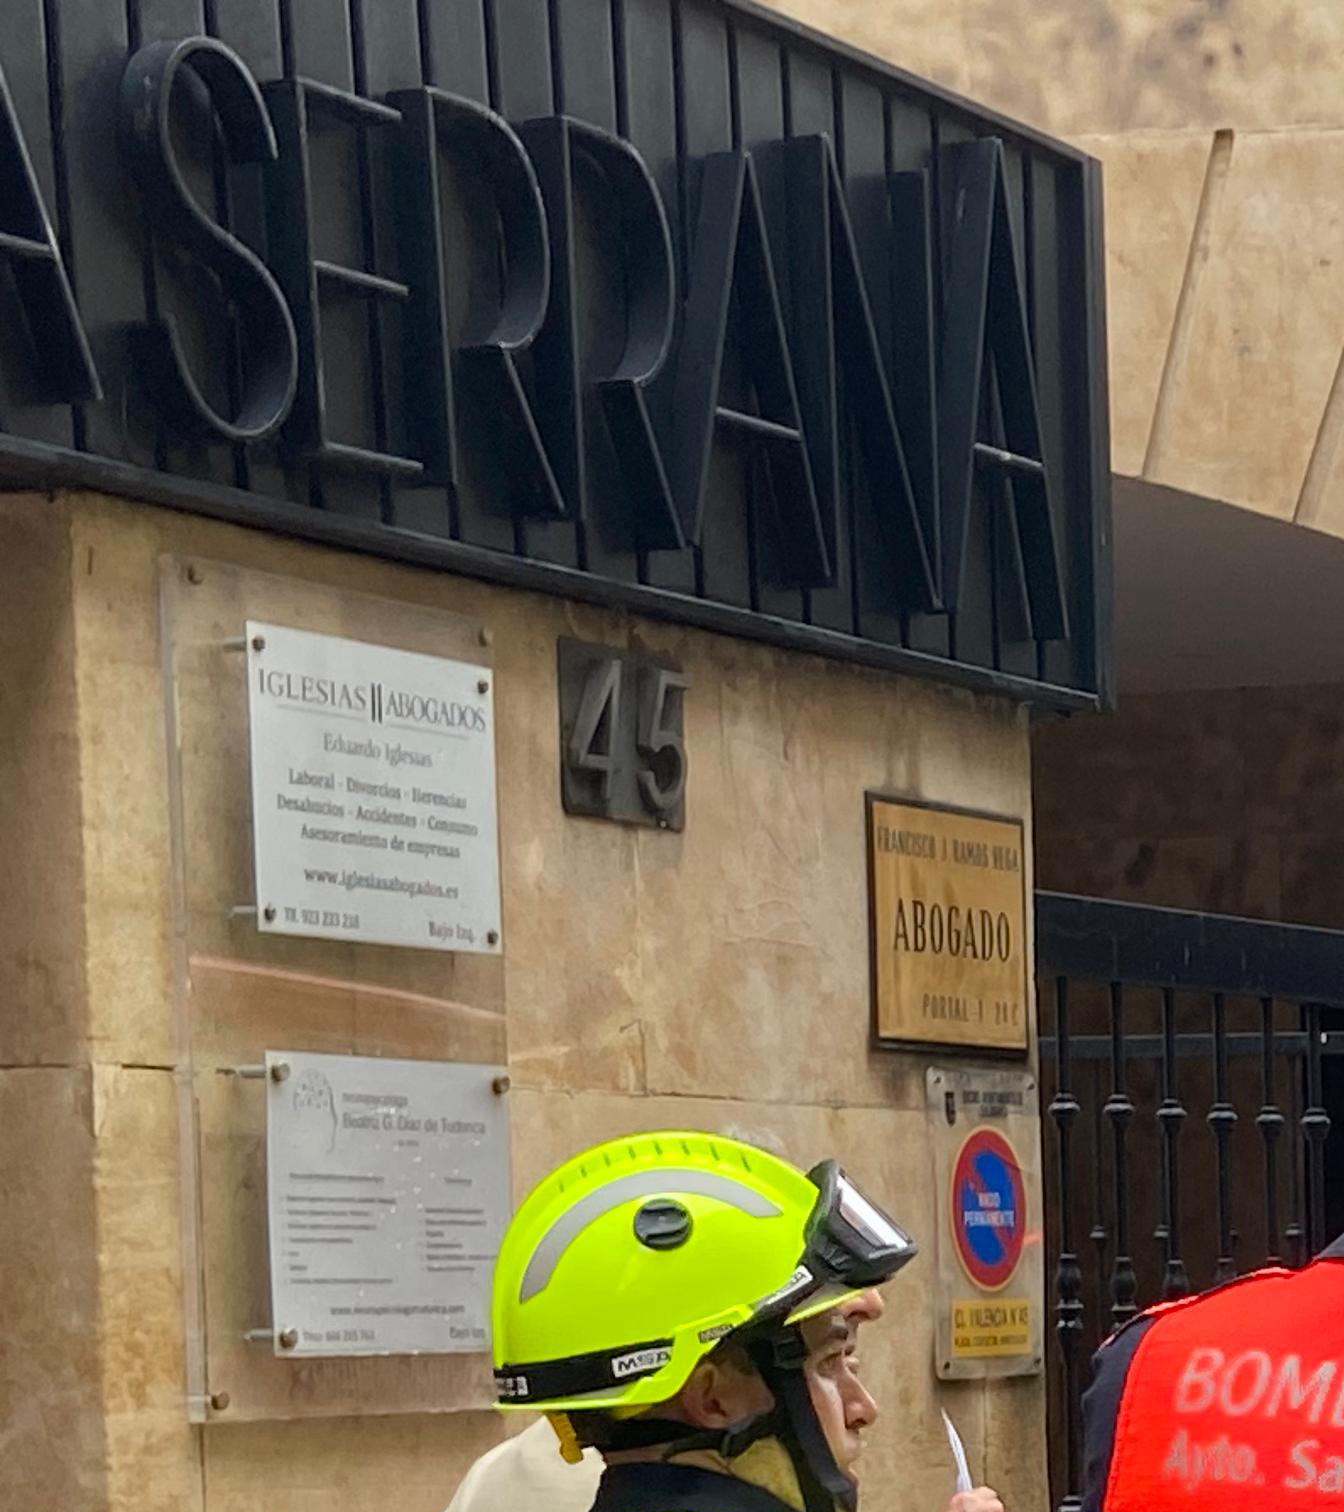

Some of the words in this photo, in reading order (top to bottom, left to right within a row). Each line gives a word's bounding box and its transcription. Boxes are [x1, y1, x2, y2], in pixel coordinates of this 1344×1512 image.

[121, 36, 1070, 640] SERRANA
[259, 667, 367, 711] IGLESIAS
[385, 690, 487, 732] ABOGADOS
[323, 732, 381, 759] Eduardo
[572, 658, 693, 812] 45
[289, 768, 335, 791] Laboral
[877, 825, 936, 860] FRANCISCO
[893, 897, 1011, 963] ABOGADO
[617, 1350, 672, 1373] MSA
[1163, 1428, 1265, 1496] Ayto.
